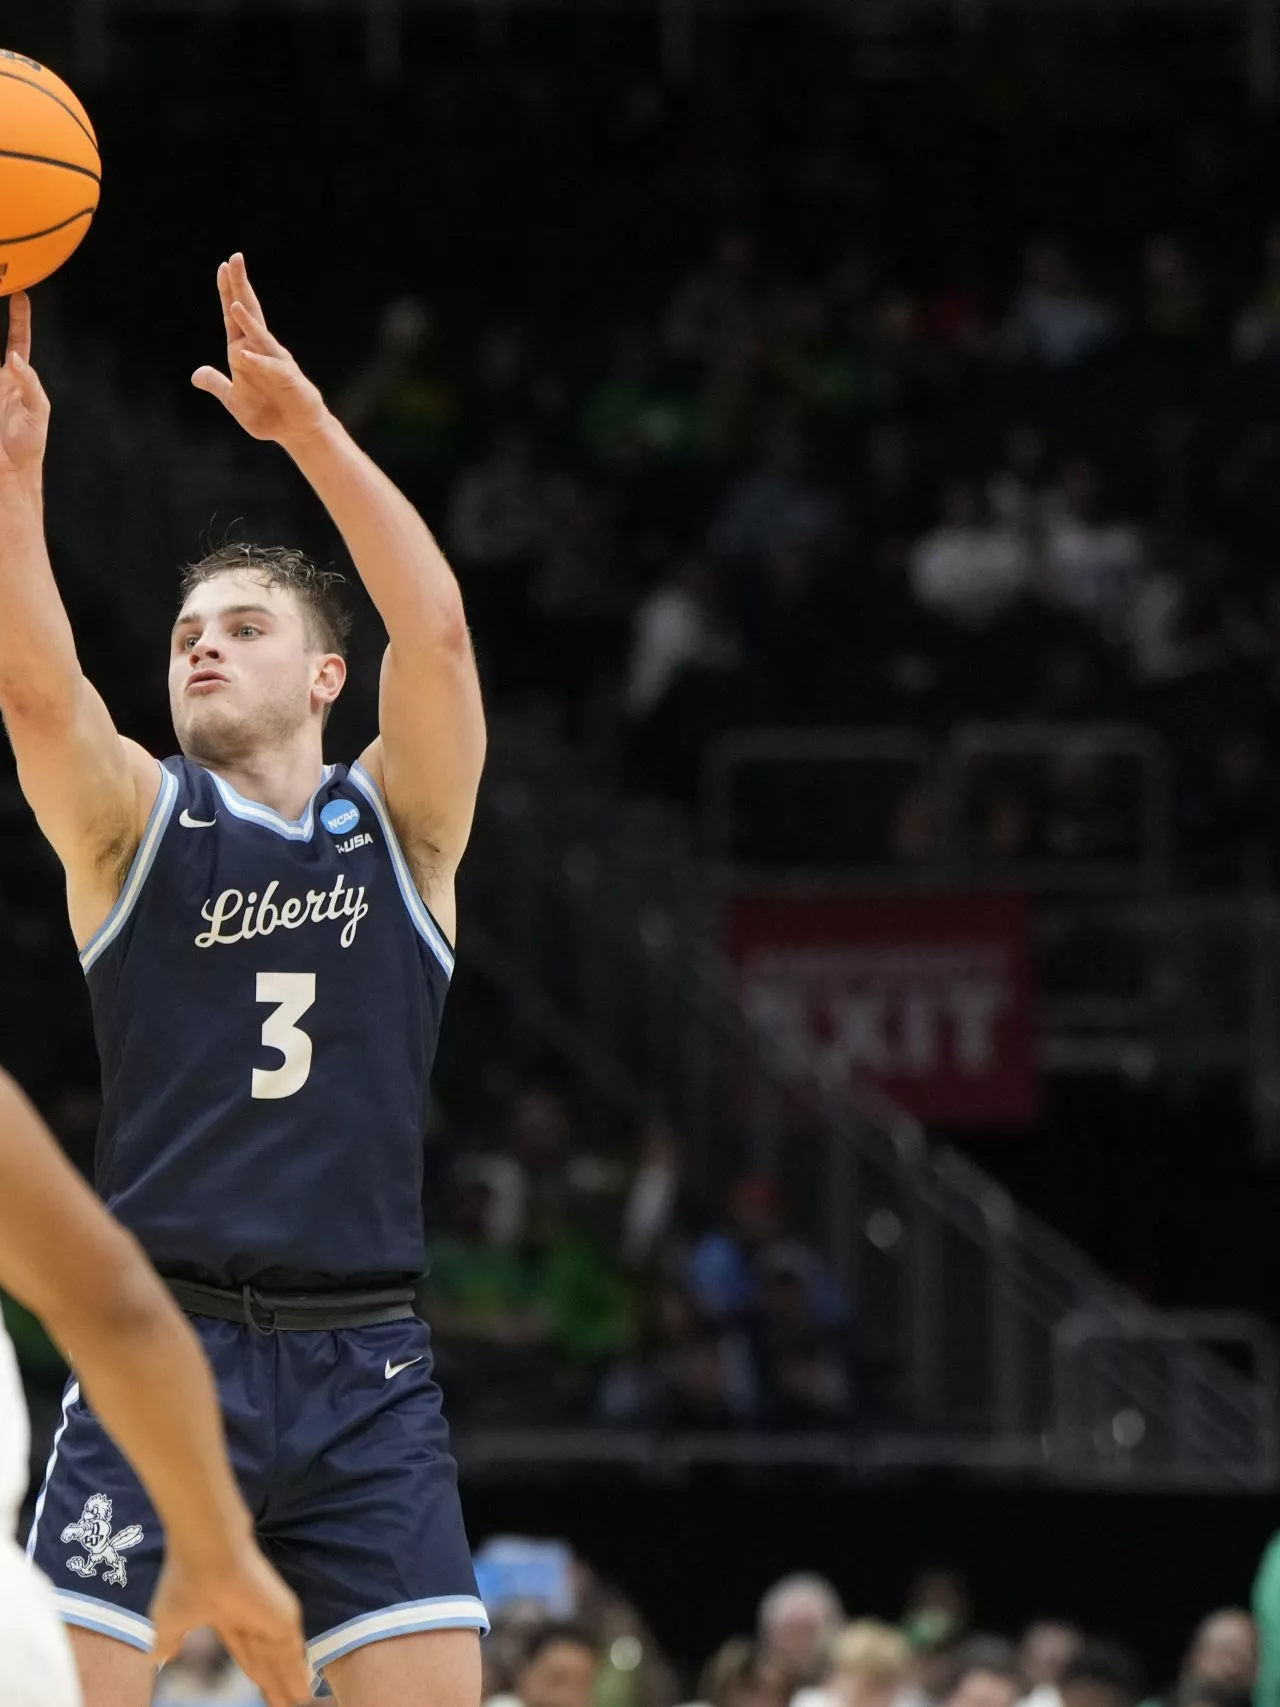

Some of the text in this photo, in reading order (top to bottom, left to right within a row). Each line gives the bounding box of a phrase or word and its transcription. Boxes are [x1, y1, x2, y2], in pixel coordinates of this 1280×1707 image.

[327, 809, 358, 830] NCAA
[194, 874, 368, 948] Liberty
[251, 971, 316, 1099] 3
